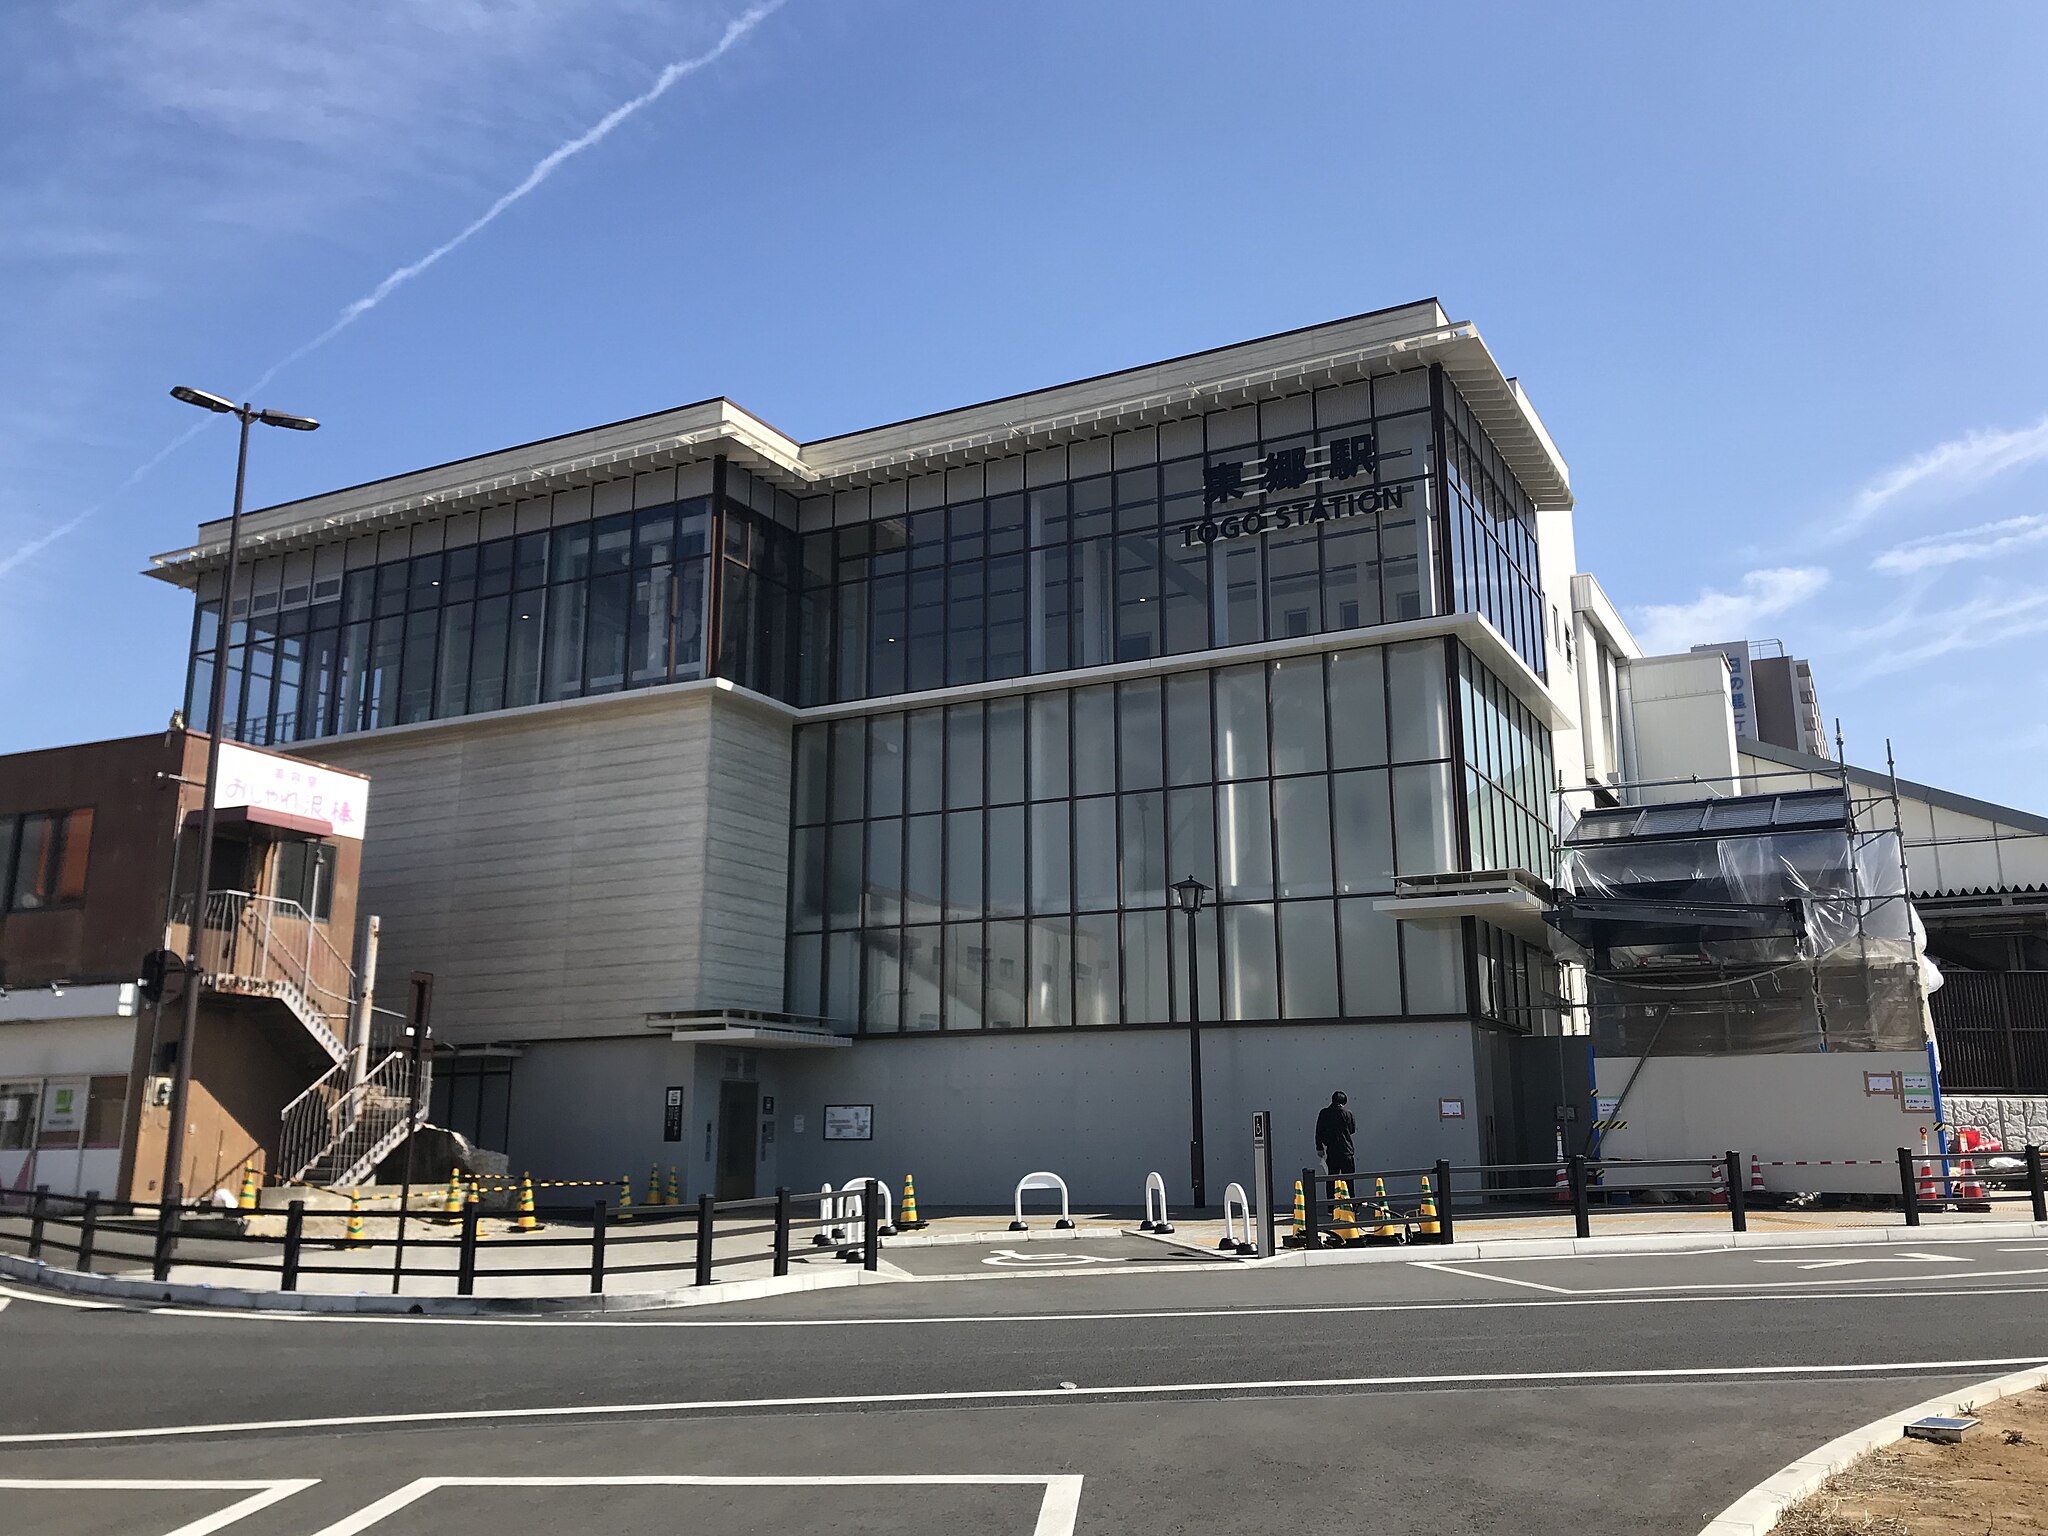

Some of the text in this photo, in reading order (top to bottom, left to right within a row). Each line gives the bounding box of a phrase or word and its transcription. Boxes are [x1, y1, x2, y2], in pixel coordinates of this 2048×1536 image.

[1202, 434, 1374, 504] 東郷駅
[1180, 486, 1403, 547] TOGO STATION
